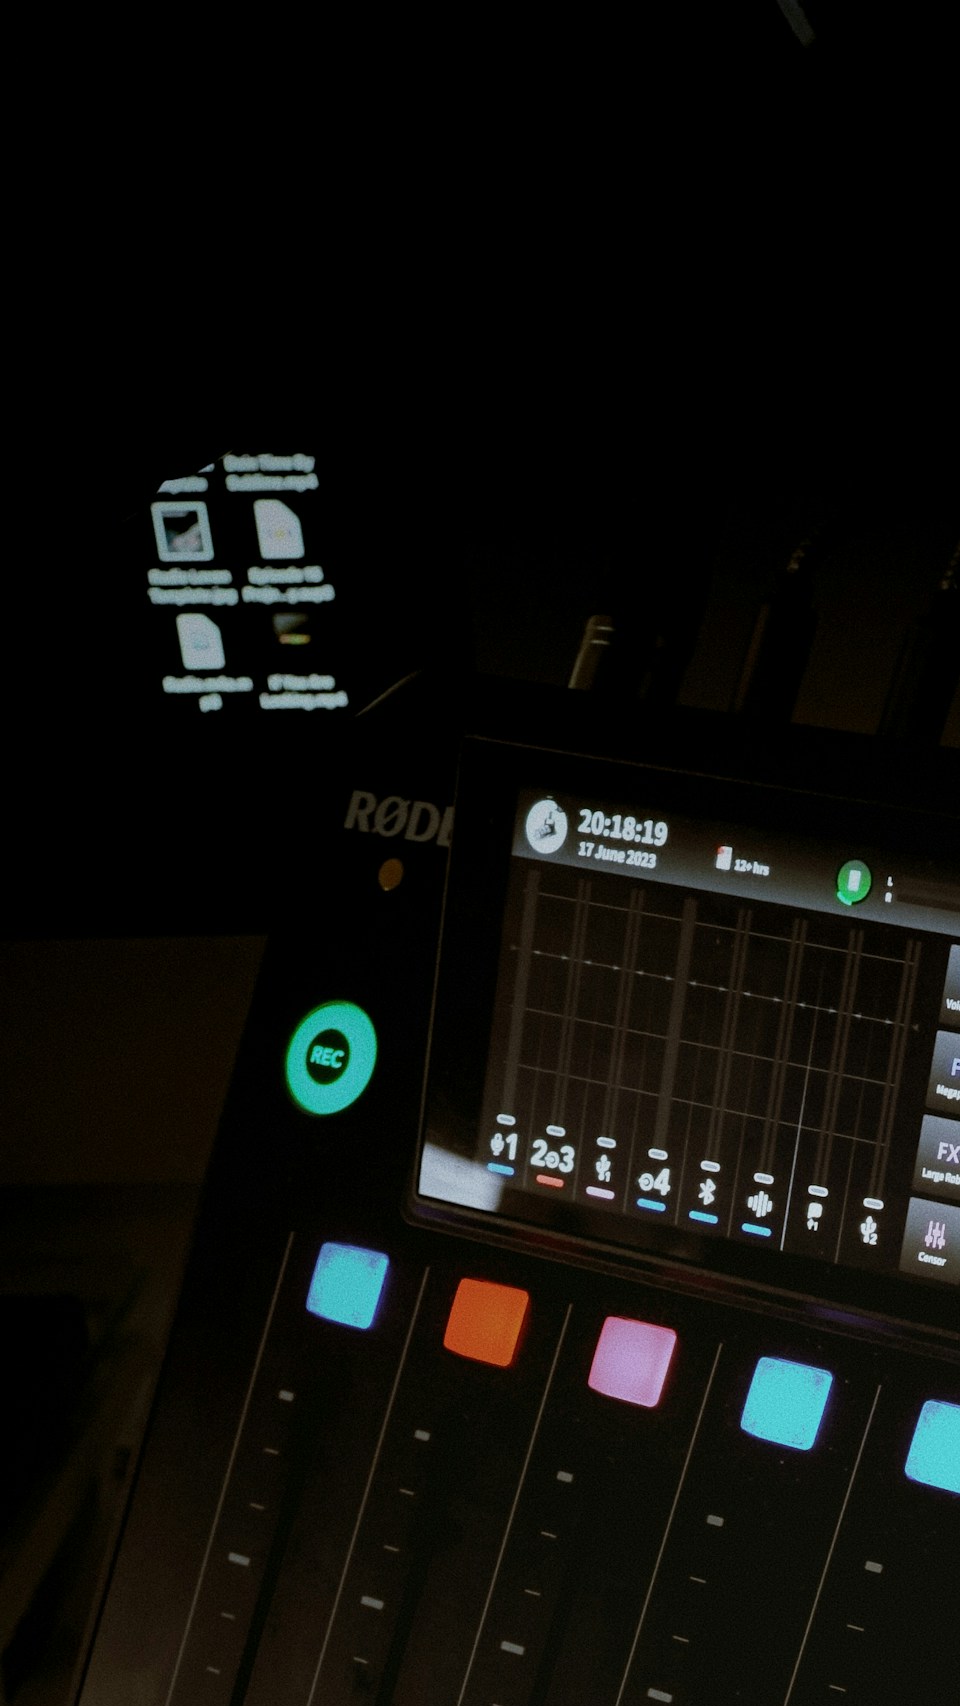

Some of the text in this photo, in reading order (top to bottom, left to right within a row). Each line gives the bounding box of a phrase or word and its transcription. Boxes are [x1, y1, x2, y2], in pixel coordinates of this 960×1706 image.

[577, 808, 669, 847] 20:18:19
[578, 841, 657, 869] 17 June 2023
[753, 862, 770, 877] hrs
[309, 1045, 345, 1070] REC
[937, 1141, 960, 1164] FX
[921, 1167, 945, 1183] Large
[918, 1250, 947, 1267] Censor
